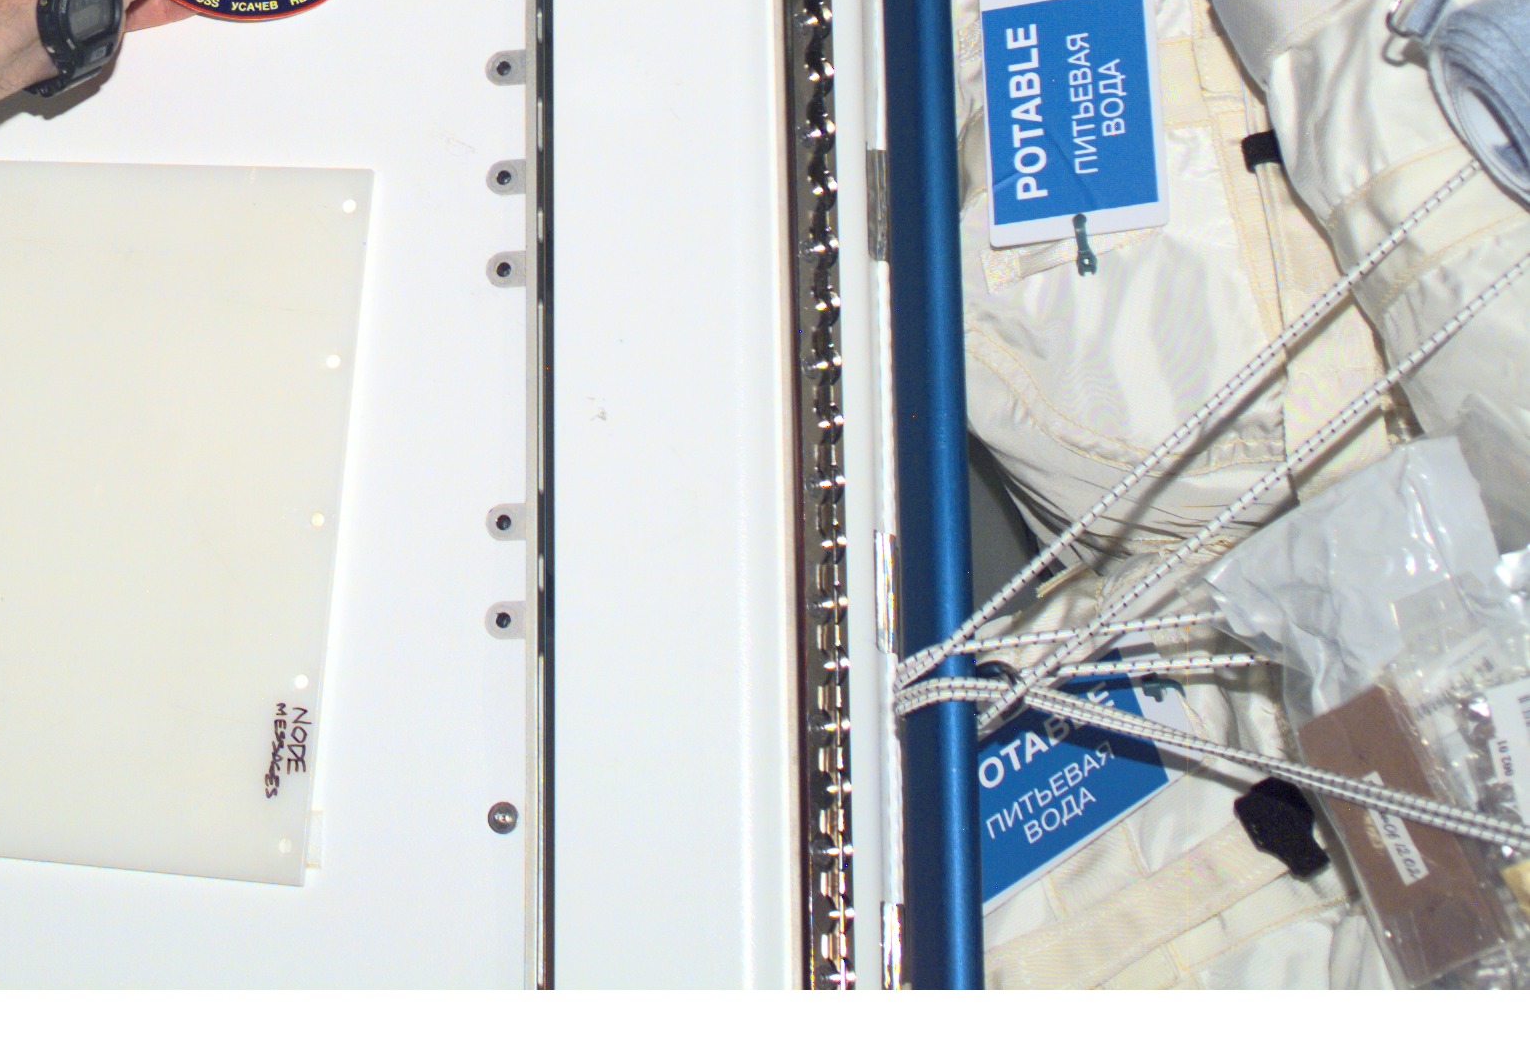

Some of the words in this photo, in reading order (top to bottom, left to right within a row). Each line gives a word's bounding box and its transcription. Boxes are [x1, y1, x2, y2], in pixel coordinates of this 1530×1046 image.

[231, 0, 280, 14] УСАЧЕВ
[1005, 23, 1048, 202] POTABLE
[1066, 32, 1100, 176] ПИТЬЕВАЯ
[1098, 58, 1128, 138] ВОДА
[287, 707, 312, 774] NODE
[986, 741, 1116, 840] ПИТЬЕВАЯ
[1023, 786, 1098, 844] ВОДА
